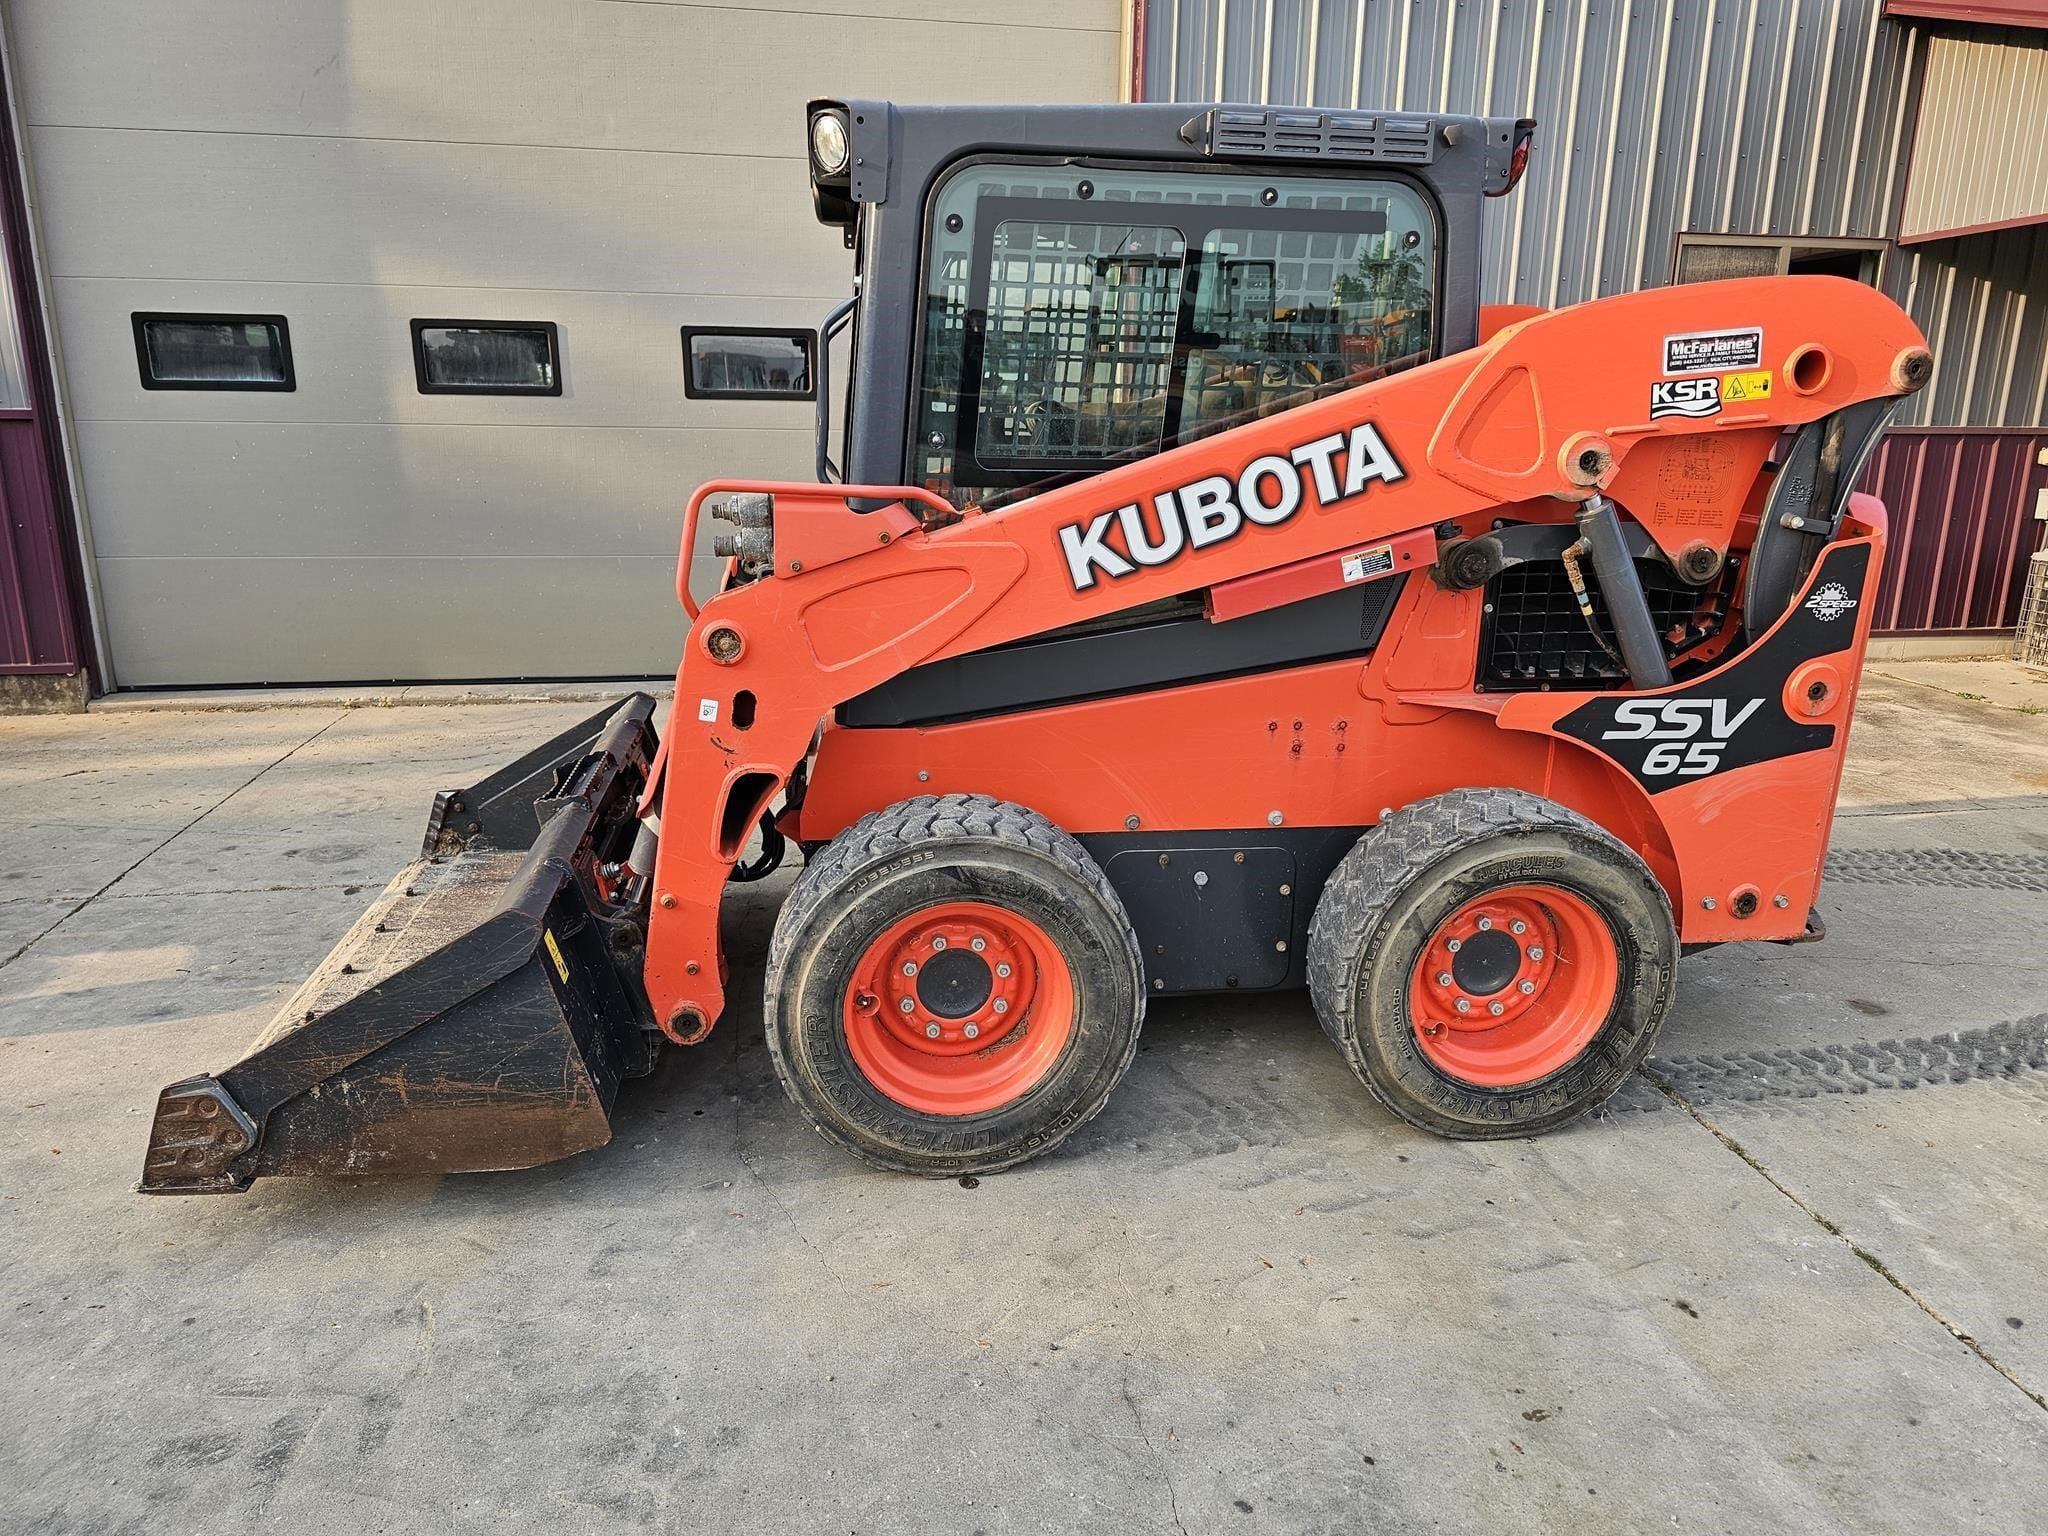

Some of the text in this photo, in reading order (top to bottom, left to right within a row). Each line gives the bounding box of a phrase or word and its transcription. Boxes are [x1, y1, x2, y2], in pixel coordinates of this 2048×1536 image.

[1671, 335, 1758, 356] McFarlanes'
[1653, 379, 1719, 405] KSR
[1059, 422, 1405, 590] KUBOTA
[1601, 698, 1767, 740] SSV
[1641, 742, 1728, 775] 65
[847, 851, 935, 895] TUBELESS
[1478, 856, 1566, 880] HERCULES
[1359, 920, 1392, 1000] TUBELESS
[1644, 961, 1671, 1034] 10-16.5
[806, 1012, 1000, 1152] LIFEMASTER
[1418, 1027, 1637, 1121] LIFEMASTER
[1007, 1111, 1080, 1158] 10-16.5
